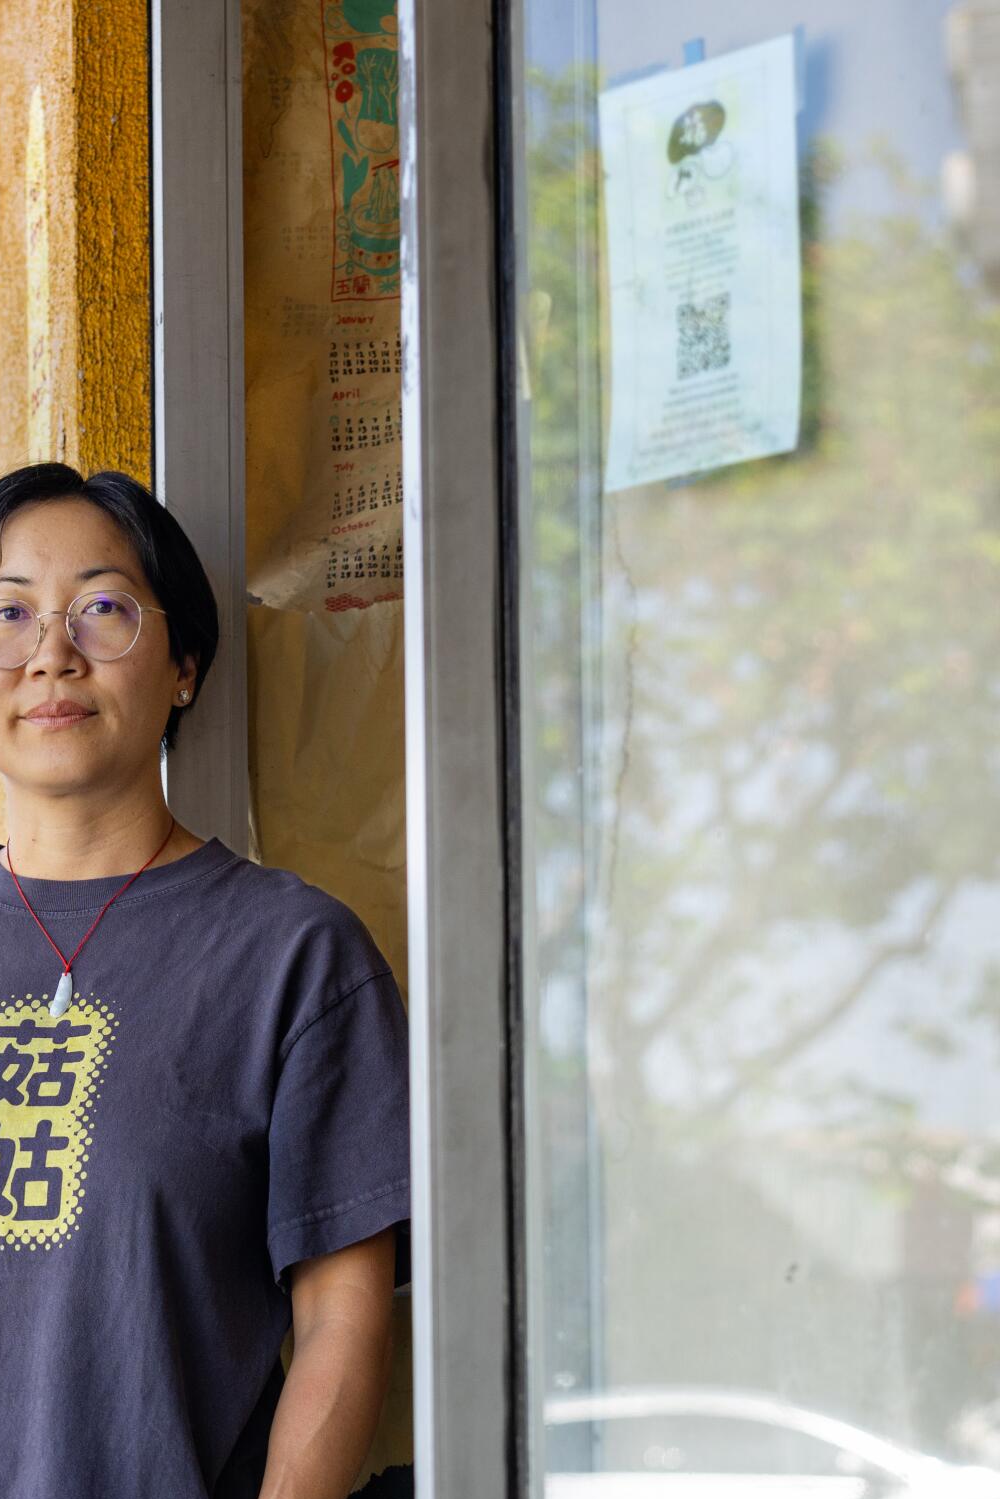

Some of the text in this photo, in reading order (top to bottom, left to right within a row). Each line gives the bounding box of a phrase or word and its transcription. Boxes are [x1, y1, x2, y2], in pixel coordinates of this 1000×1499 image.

[336, 315, 374, 325] January
[332, 388, 360, 401] April
[333, 462, 354, 473] July
[332, 520, 376, 535] October
